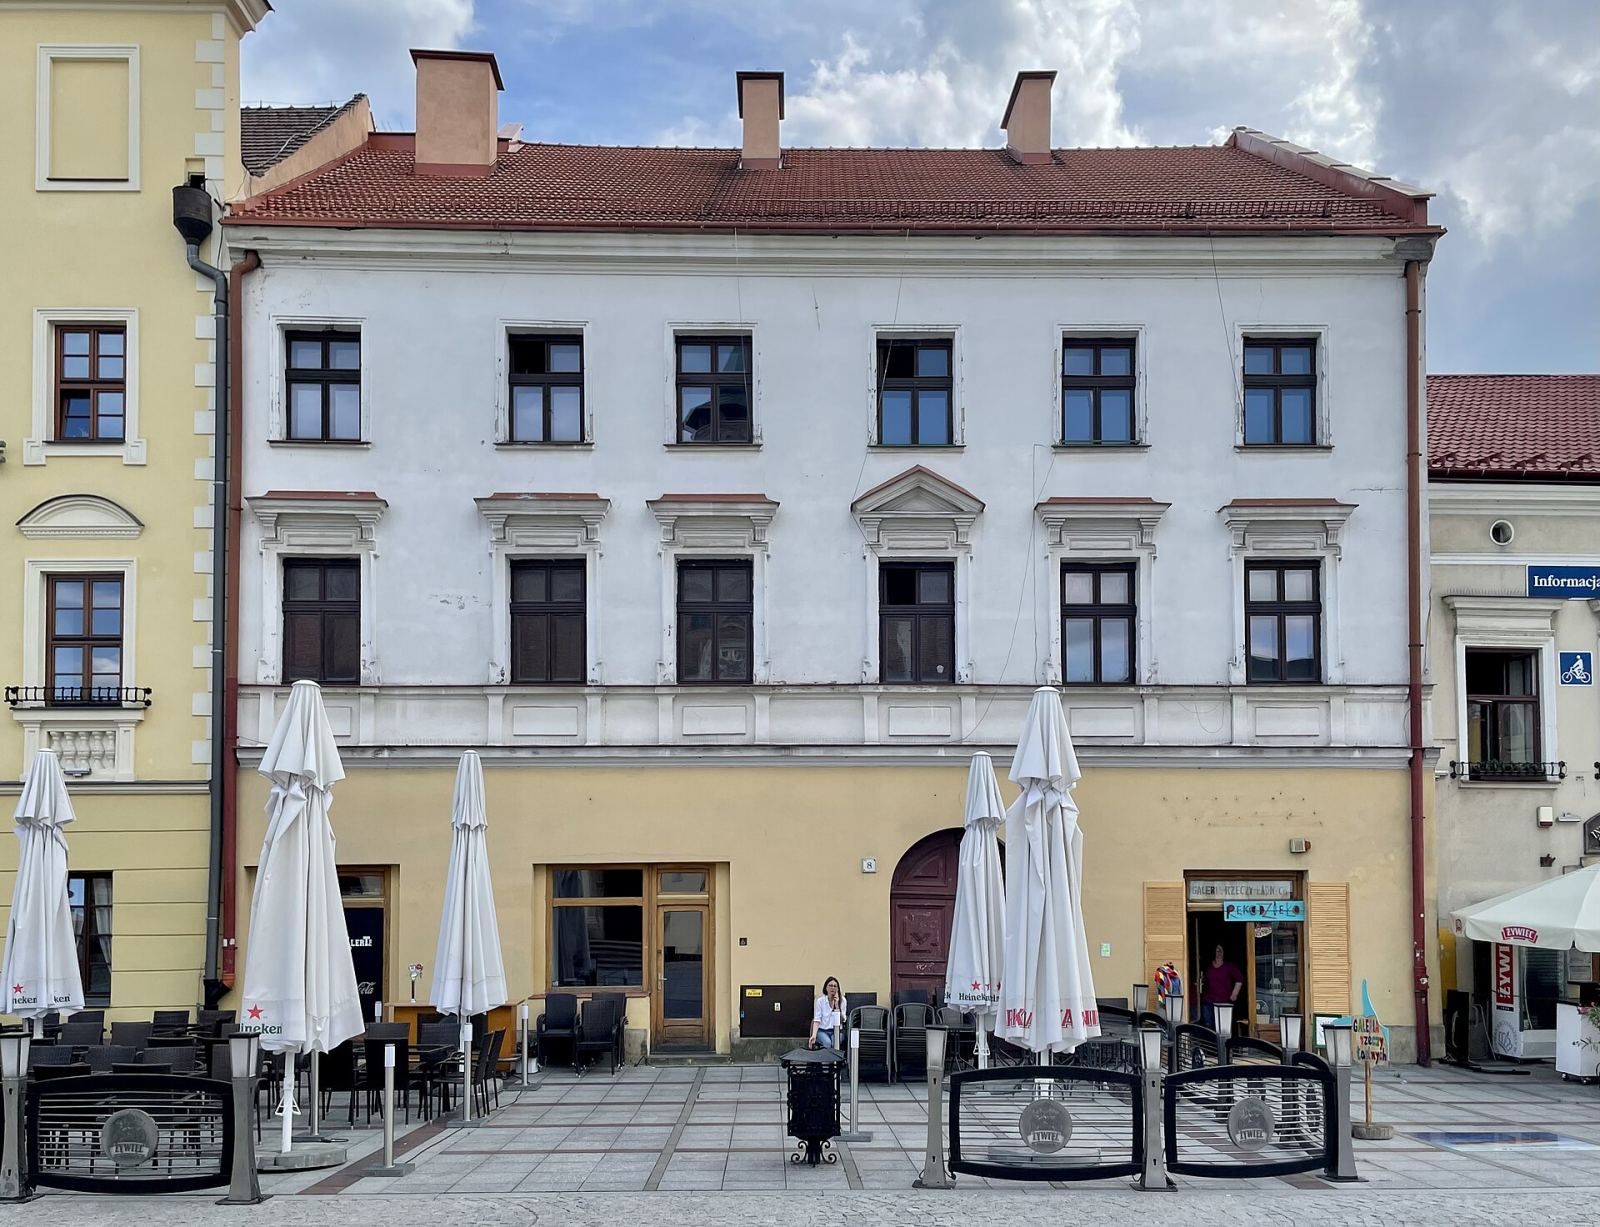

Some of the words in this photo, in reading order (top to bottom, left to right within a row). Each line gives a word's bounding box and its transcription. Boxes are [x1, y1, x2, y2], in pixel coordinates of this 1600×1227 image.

[866, 861, 873, 870] 8
[1499, 944, 1511, 999] ŻYWI
[241, 1022, 283, 1035] ineken
